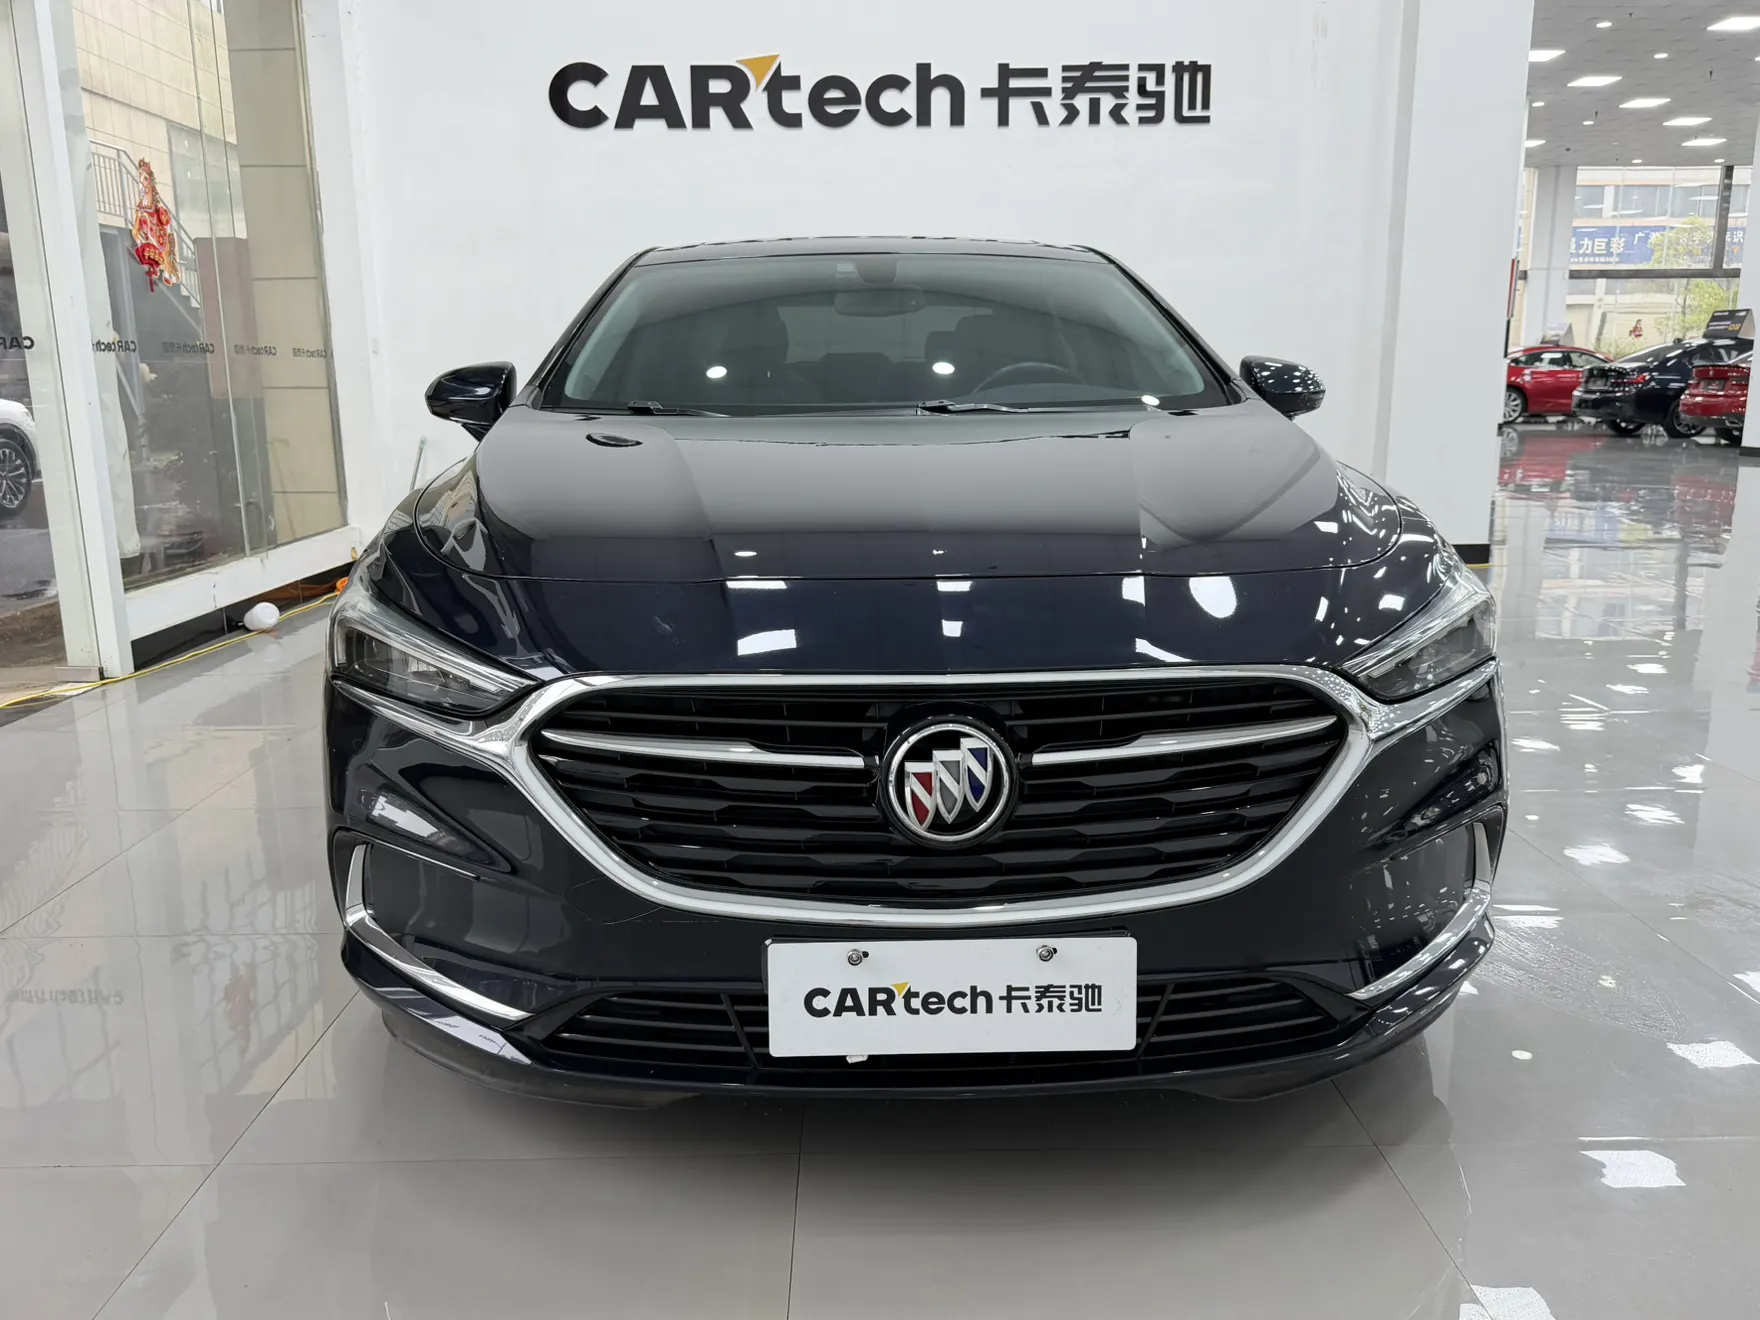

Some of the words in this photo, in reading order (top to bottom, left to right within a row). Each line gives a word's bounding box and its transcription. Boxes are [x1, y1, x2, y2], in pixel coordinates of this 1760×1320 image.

[548, 55, 966, 130] CARtech
[980, 61, 1212, 128] 卡泰驰
[803, 981, 993, 1018] CARtech
[998, 983, 1103, 1014] 卡泰驰
